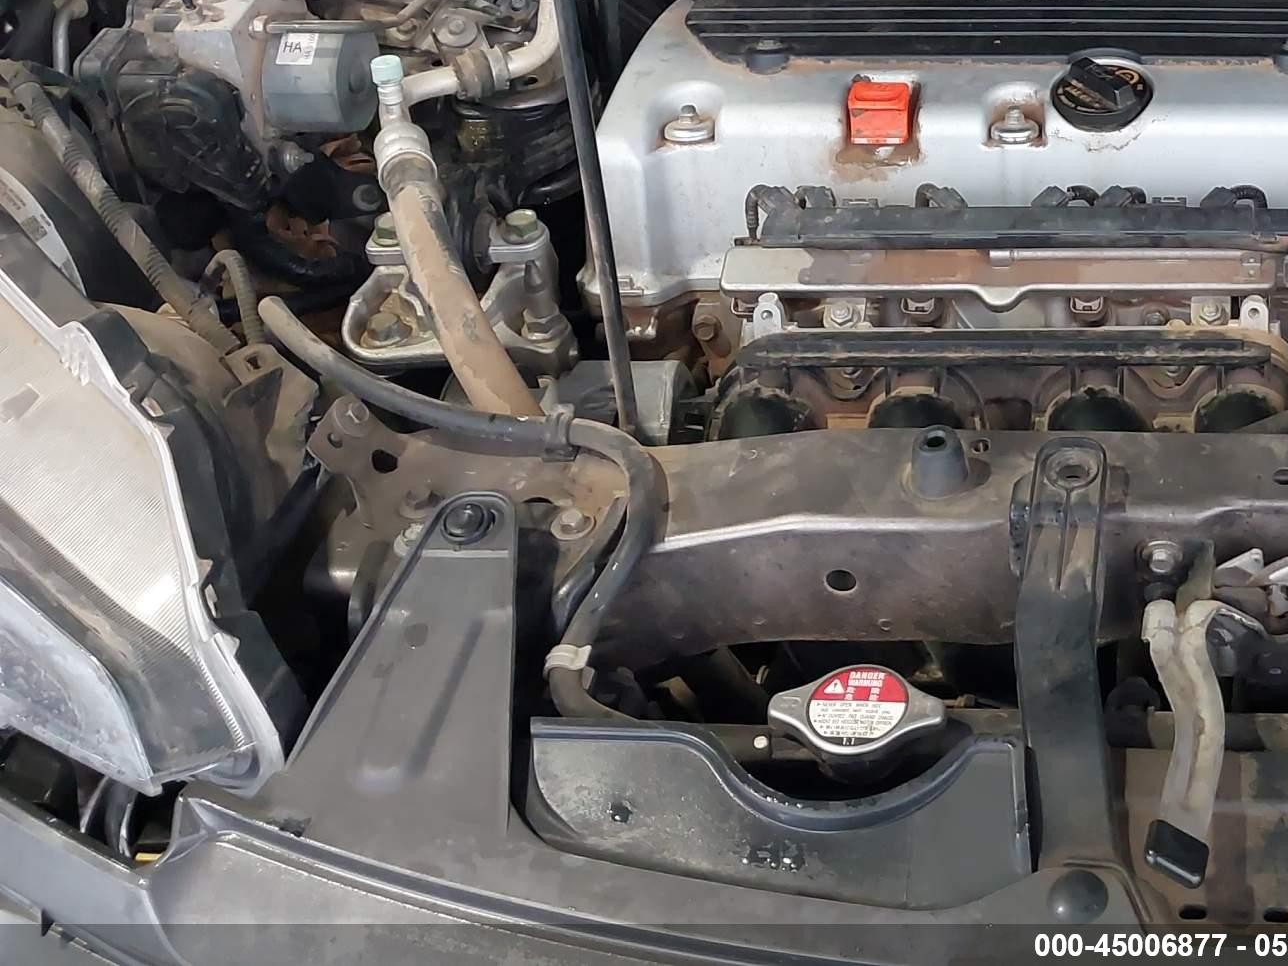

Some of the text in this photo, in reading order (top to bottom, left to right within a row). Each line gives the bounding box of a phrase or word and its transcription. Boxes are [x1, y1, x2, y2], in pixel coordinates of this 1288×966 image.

[283, 41, 302, 53] HA
[850, 671, 885, 680] DANGER
[848, 679, 883, 687] WARNING
